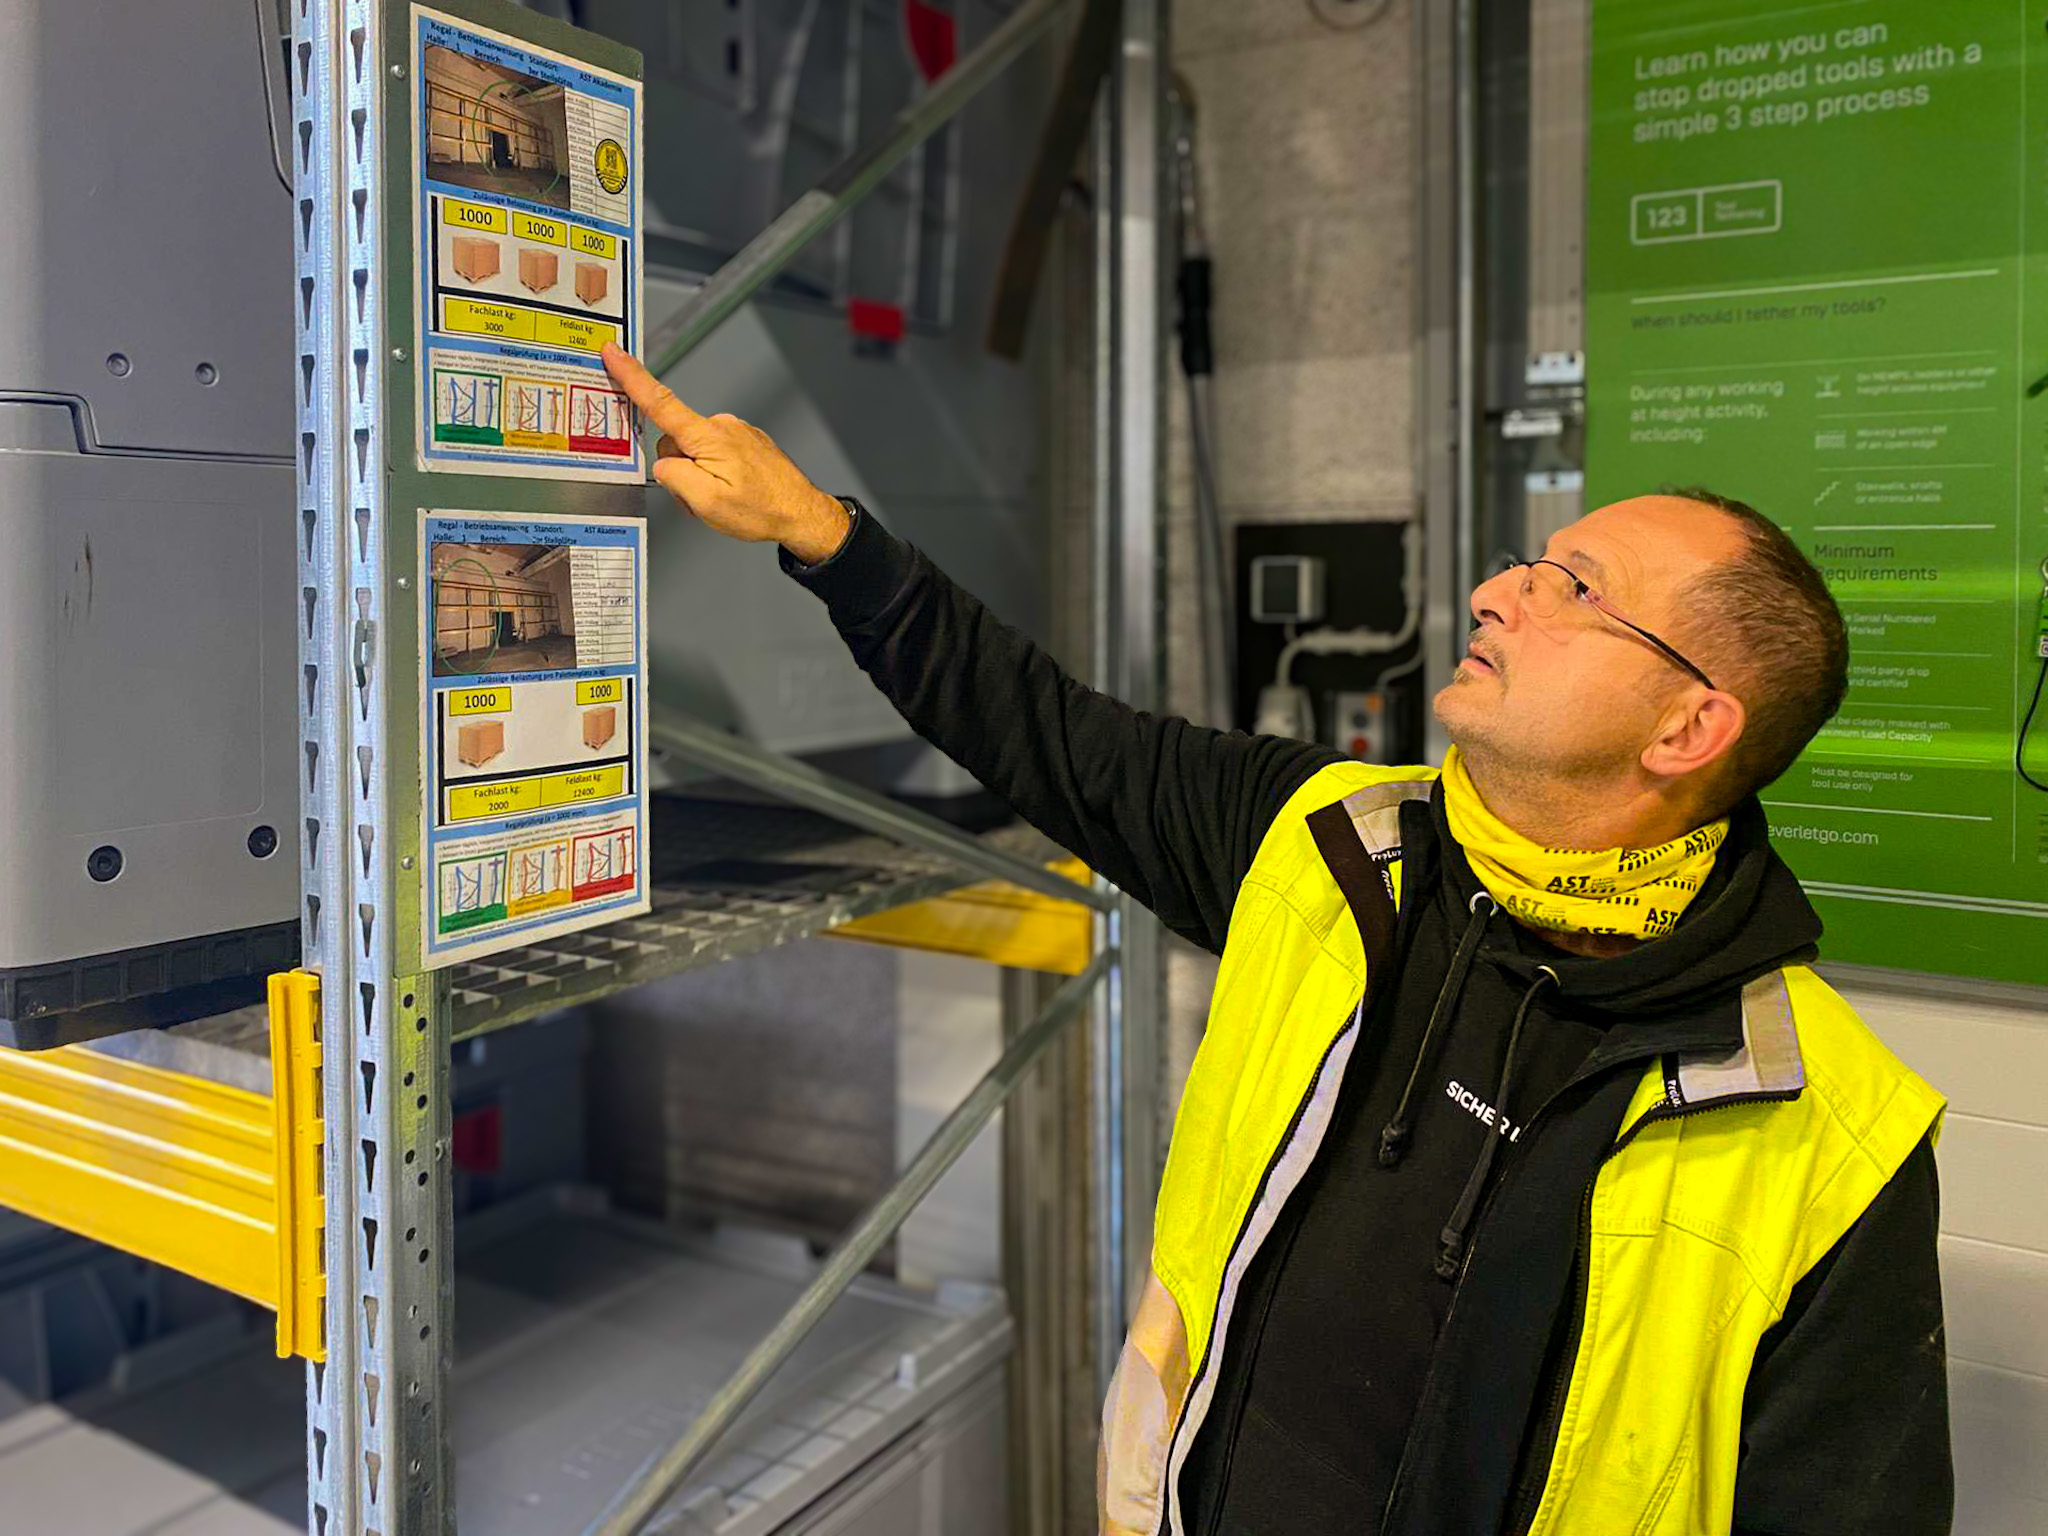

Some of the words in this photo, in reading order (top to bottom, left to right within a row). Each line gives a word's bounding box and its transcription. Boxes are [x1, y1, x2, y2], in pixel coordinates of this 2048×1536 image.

[1634, 49, 1708, 80] Learn
[1715, 43, 1771, 68] how
[1777, 33, 1827, 63] you
[1835, 22, 1888, 49] can
[1634, 85, 1690, 112] stop
[1697, 63, 1806, 101] dropped
[1815, 55, 1884, 85] tools
[1893, 43, 1954, 73] with
[1963, 42, 1982, 64] a
[1633, 111, 1718, 143] simple
[1725, 105, 1741, 130] 3
[1749, 98, 1808, 128] step
[1817, 84, 1929, 124] process
[459, 208, 493, 225] 1000
[1647, 206, 1687, 229] 123
[527, 222, 554, 238] 1000
[583, 234, 605, 251] 1000
[469, 305, 504, 317] Fachlast
[1631, 315, 1675, 330] When
[1679, 307, 1733, 328] should
[1746, 304, 1797, 323] tether
[1801, 303, 1828, 321] my
[1833, 297, 1887, 316] tools?
[484, 322, 504, 333] 3000
[559, 319, 583, 331] Feldlast
[568, 335, 587, 346] 12400
[1630, 384, 1682, 403] During
[1685, 385, 1715, 401] any
[1718, 380, 1784, 399] working
[1630, 409, 1646, 423] at
[1650, 406, 1701, 424] height
[1630, 428, 1708, 444] including:
[438, 521, 458, 531] Regal
[1814, 544, 1895, 559] Minimum
[1883, 613, 1937, 624] Numbered
[1848, 626, 1885, 636] Marked
[1906, 667, 1930, 677] drop
[589, 684, 612, 698] 1000
[1867, 679, 1909, 689] certified
[465, 694, 496, 708] 1000
[1888, 719, 1927, 730] marked
[1929, 720, 1951, 731] with
[1862, 729, 1886, 740] Load
[1888, 730, 1933, 744] Capacity
[565, 775, 592, 785] Feldlast
[1811, 766, 1835, 776] Must
[1837, 767, 1850, 777] be
[1852, 769, 1898, 781] designed
[1899, 771, 1914, 780] for
[474, 786, 508, 798] Fachlast
[573, 787, 595, 797] 12400
[1811, 779, 1830, 789] tool
[1832, 780, 1851, 790] use
[1852, 781, 1873, 792] only
[489, 801, 509, 812] 2000
[1768, 824, 1879, 845] everletgo.com
[1546, 875, 1591, 889] AST
[1506, 894, 1543, 915] AST
[1645, 908, 1679, 927] AST
